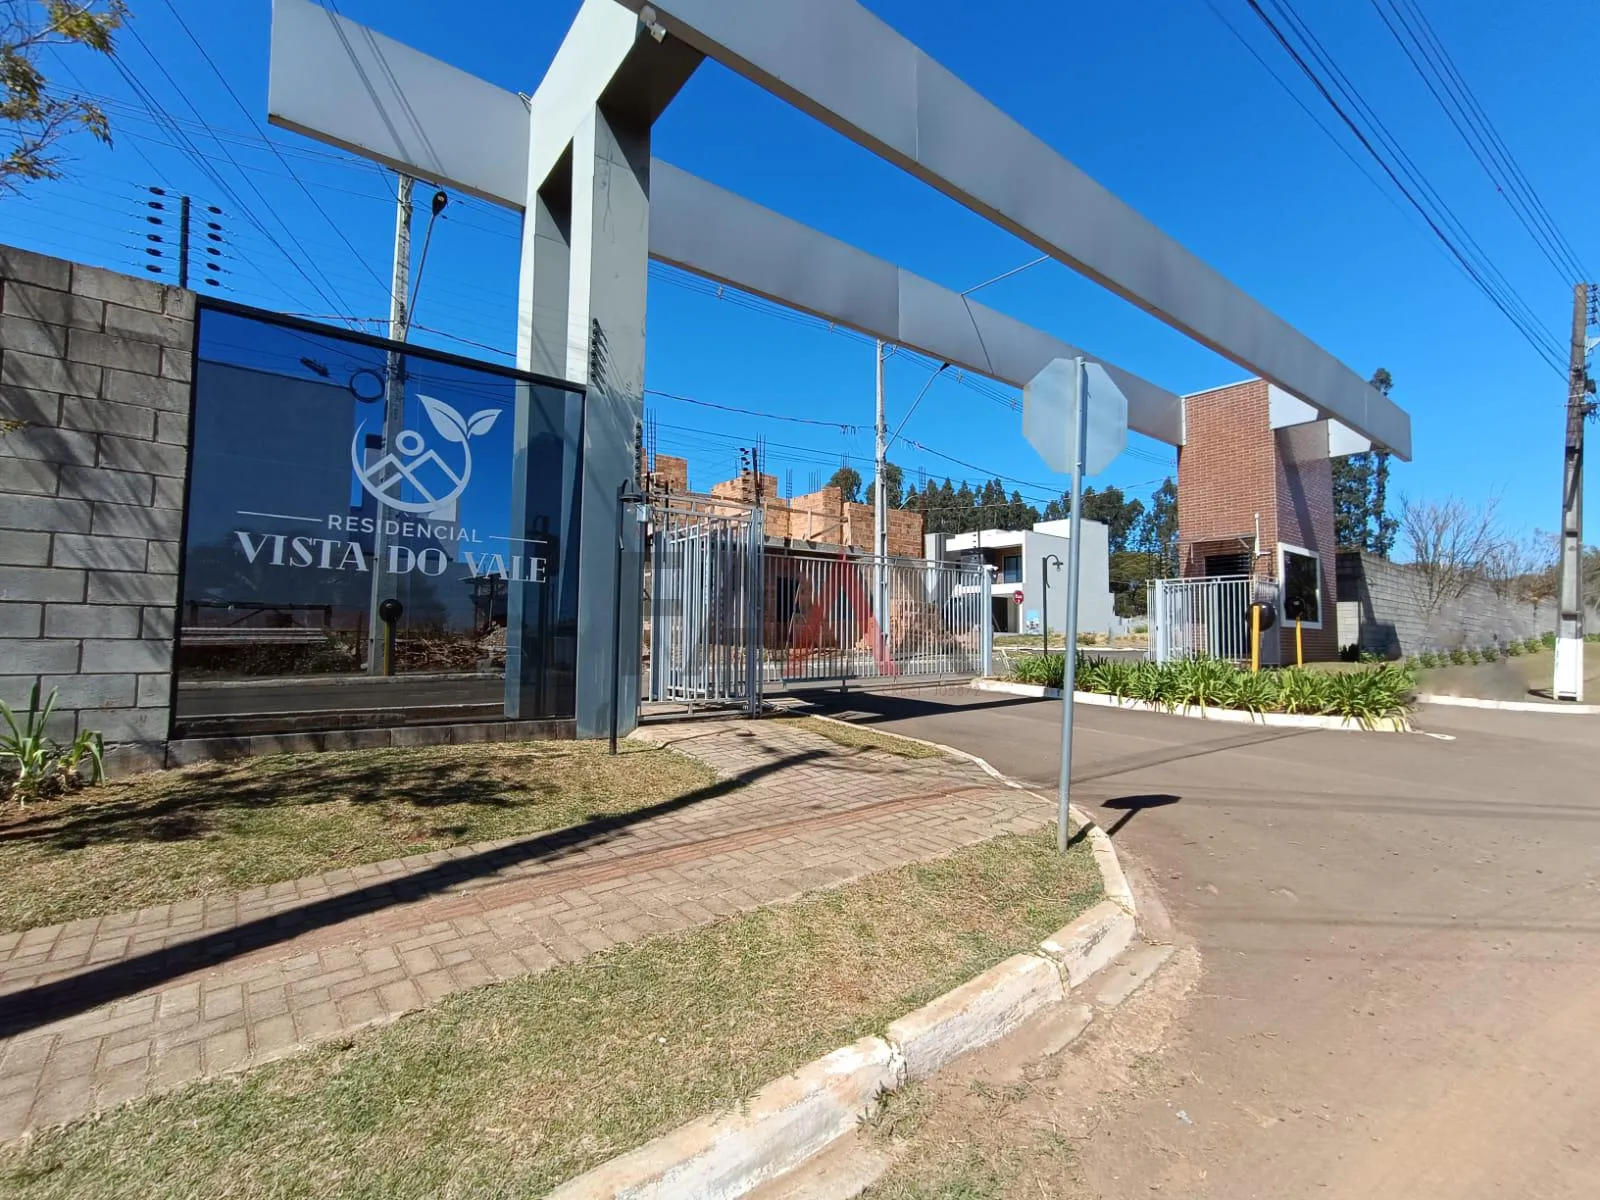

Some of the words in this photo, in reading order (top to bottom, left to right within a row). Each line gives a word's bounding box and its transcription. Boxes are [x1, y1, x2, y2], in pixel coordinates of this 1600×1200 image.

[328, 514, 484, 543] RESIDENCIAL
[233, 530, 370, 572] VISTA
[386, 545, 448, 577] DO
[463, 551, 547, 584] VALE
